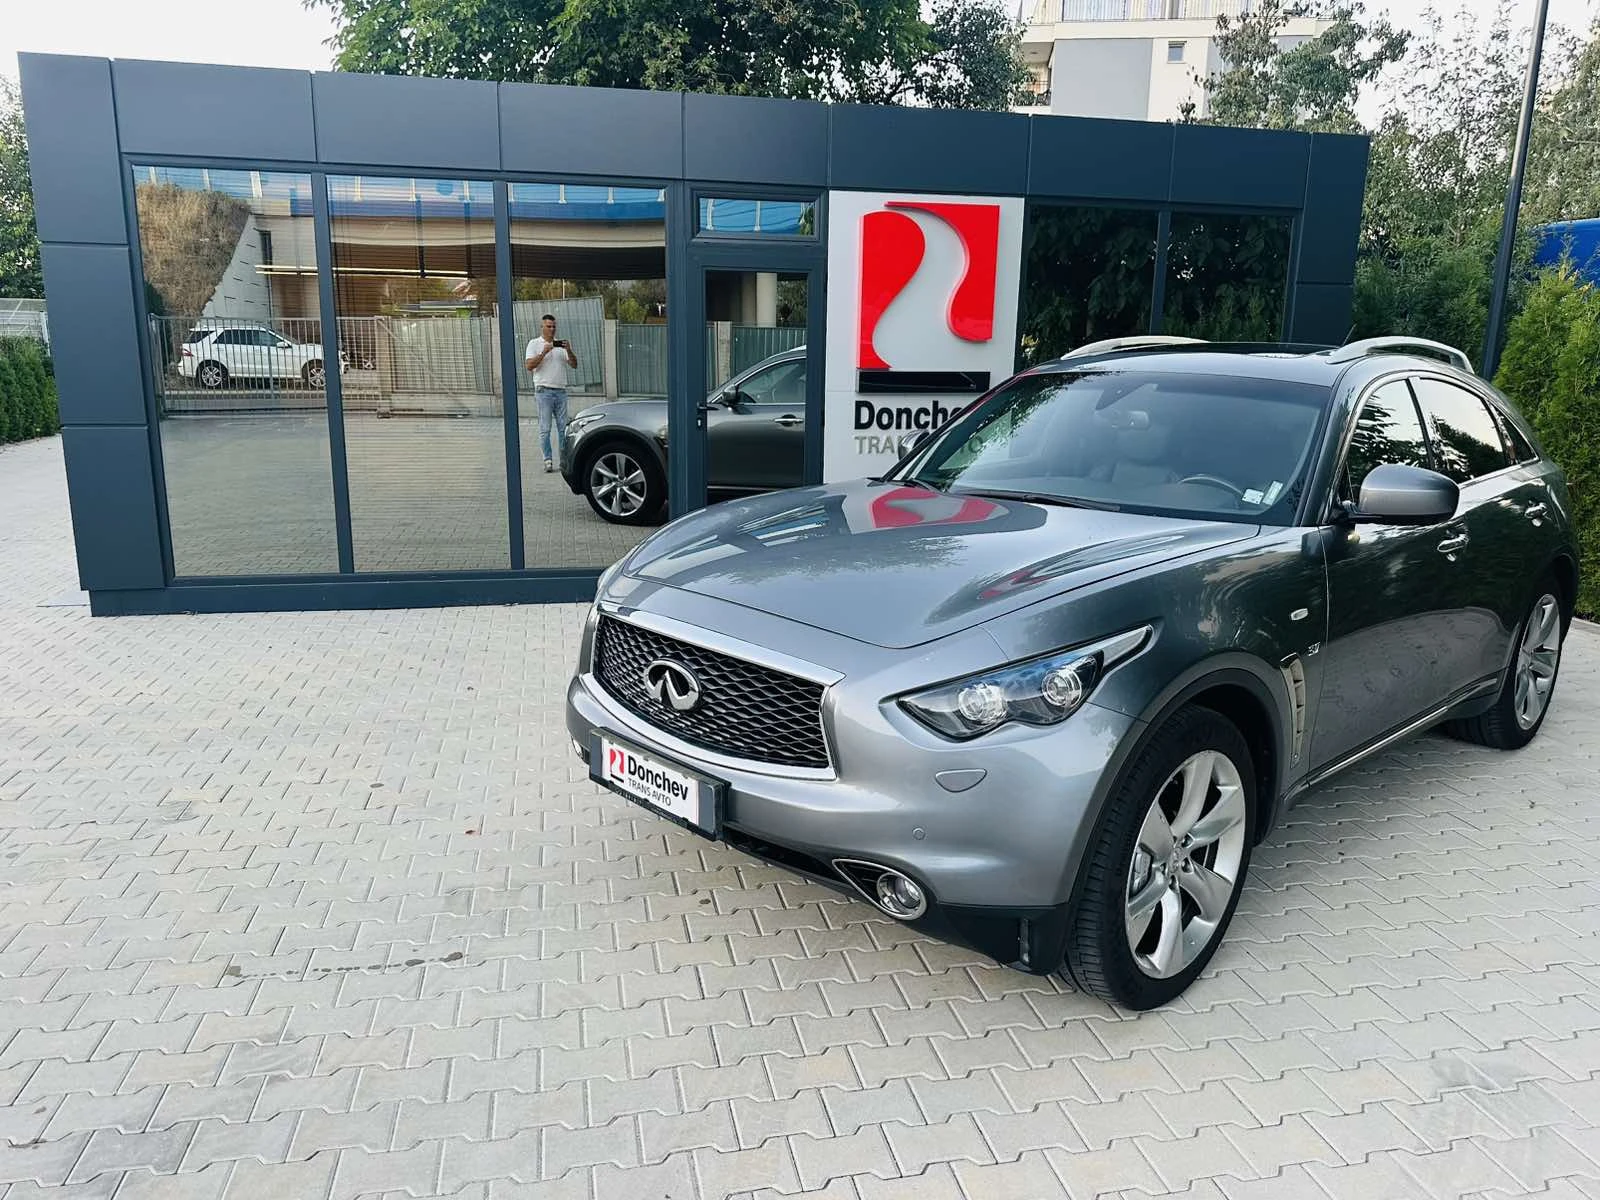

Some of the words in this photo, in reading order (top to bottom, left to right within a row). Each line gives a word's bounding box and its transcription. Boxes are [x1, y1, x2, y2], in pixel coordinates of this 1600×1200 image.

[854, 400, 965, 430] Donch
[854, 436, 900, 455] TRA
[628, 755, 688, 800] Donchev
[628, 778, 651, 797] TRANS
[651, 790, 672, 806] AVTO
